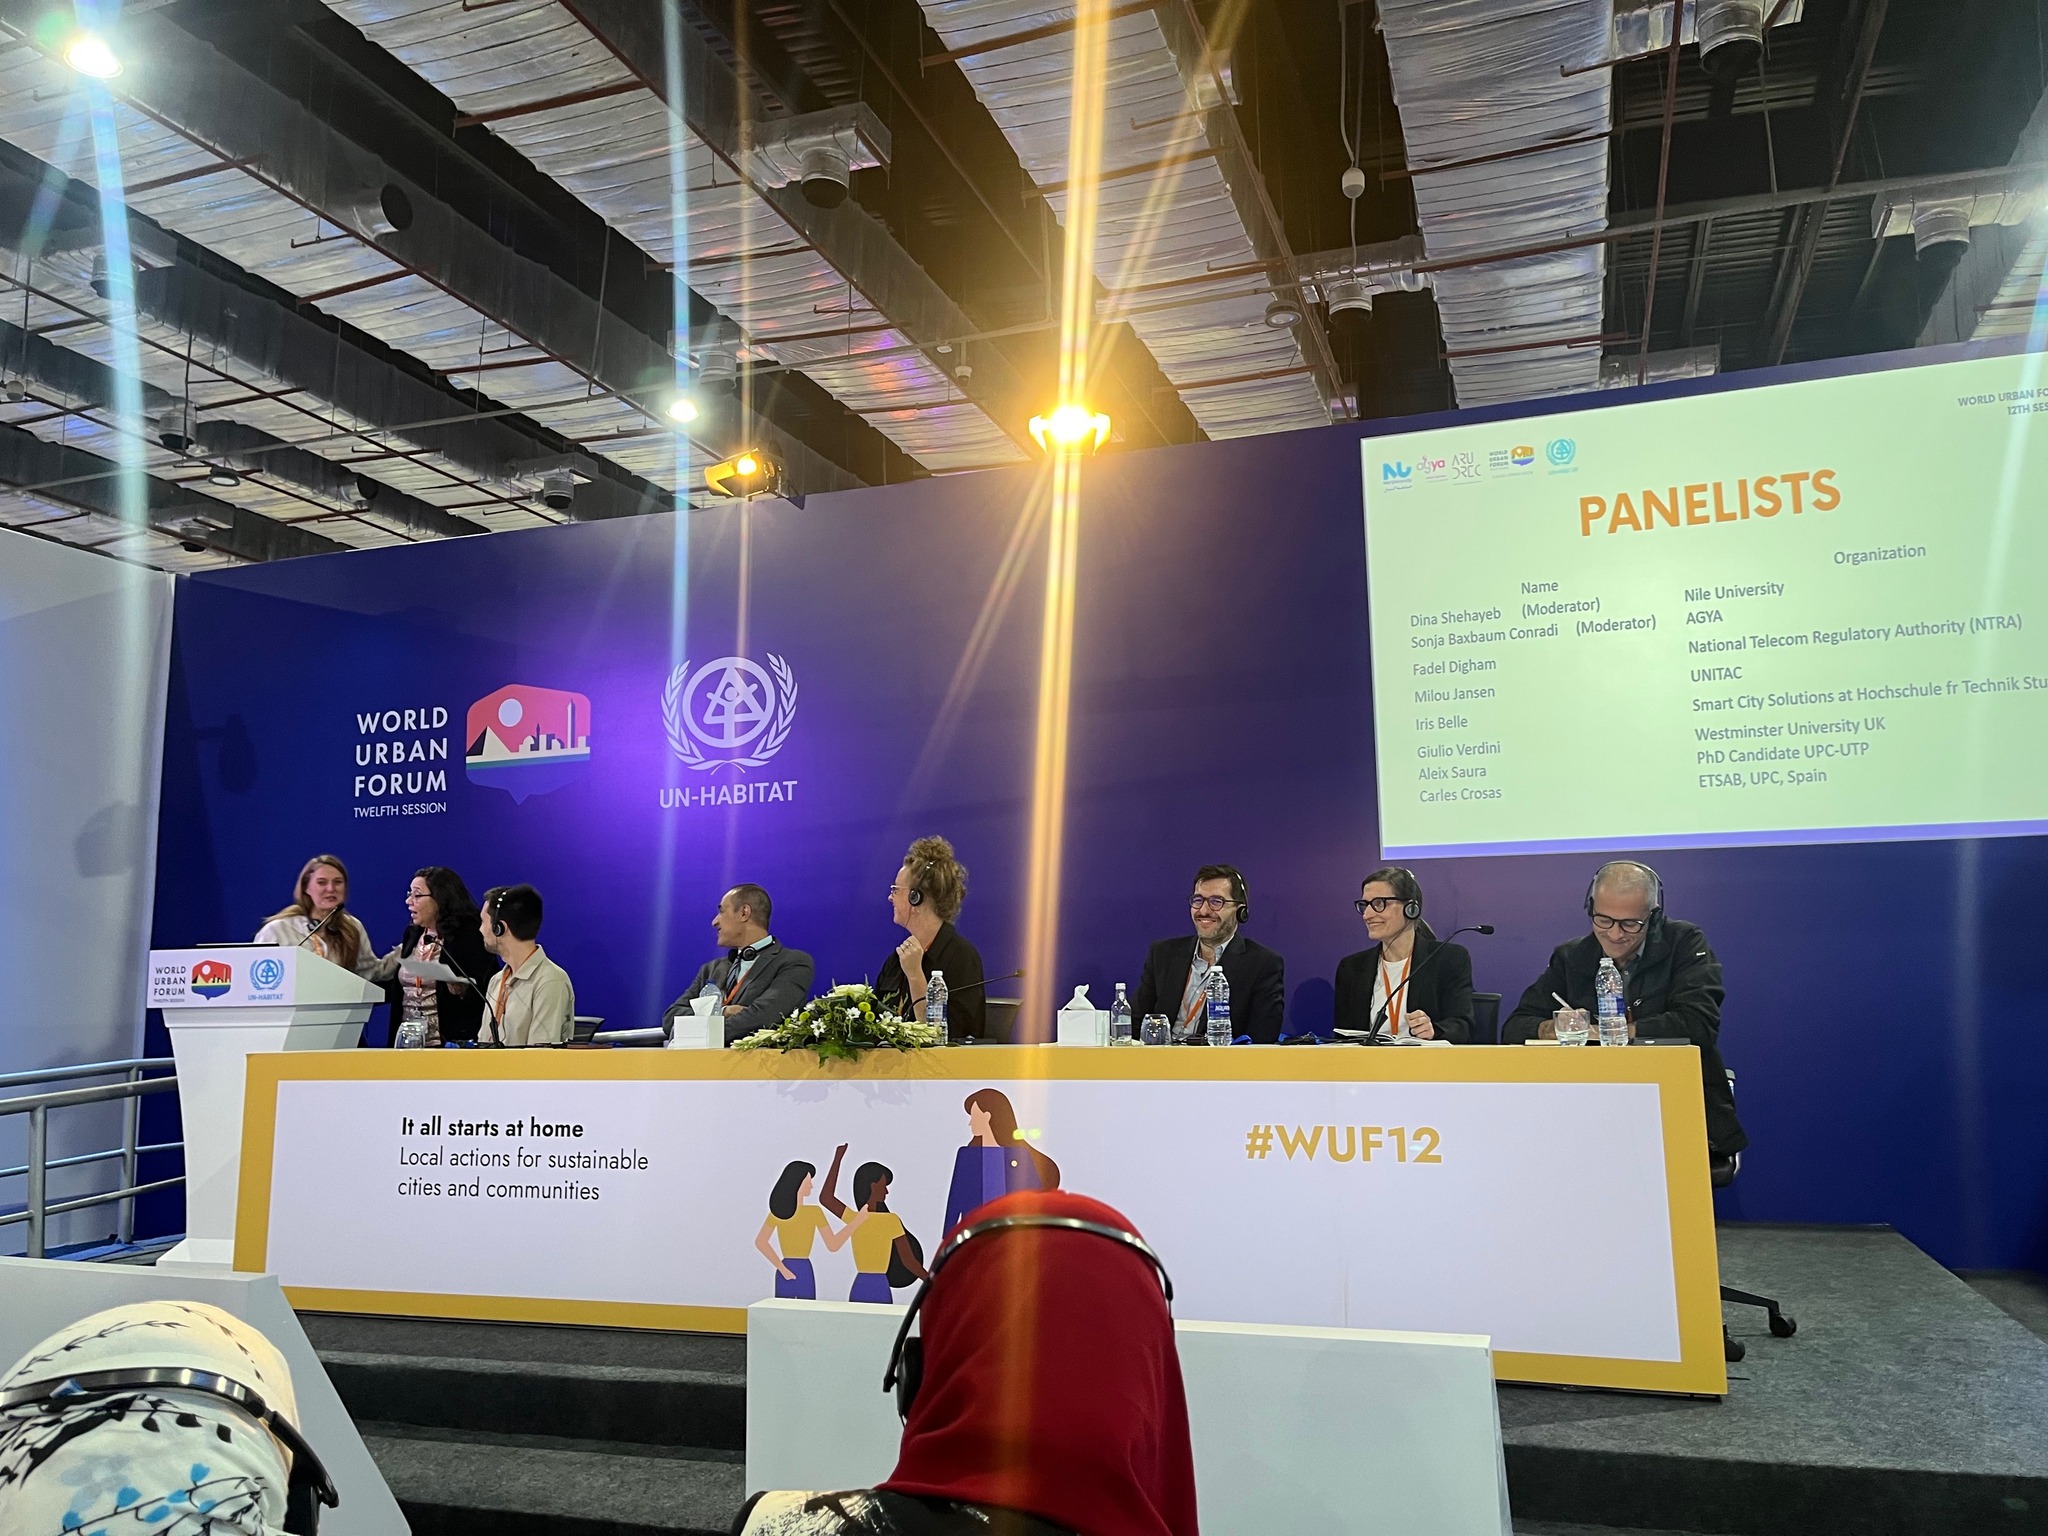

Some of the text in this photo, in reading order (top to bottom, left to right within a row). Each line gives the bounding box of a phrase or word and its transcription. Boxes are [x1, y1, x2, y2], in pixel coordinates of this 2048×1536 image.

[1957, 394, 1996, 406] WORLD
[1998, 390, 2034, 402] URBAN
[2007, 404, 2031, 416] 12TH
[1579, 469, 1842, 537] PANELISTS
[1833, 545, 1926, 566] Organization
[1521, 581, 1559, 594] Name
[1684, 582, 1785, 602] Nile University
[1410, 597, 1600, 627] Dina Shehayeb (Moderator)
[1685, 609, 1724, 625] AGYA
[1411, 614, 1657, 649] Sonja Baxbaum Conradi (Moderator)
[1688, 613, 2023, 654] National Telecom Regulatory Authority (NTRA)
[1413, 659, 1497, 676] Fadel Digham
[1690, 666, 1743, 683] UNITAC
[1414, 688, 1495, 703] Milou Jansen
[1692, 697, 1734, 712] Smart
[1737, 693, 1764, 710] City
[1768, 690, 1835, 707] Solutions
[1838, 689, 1853, 702] at
[1856, 682, 1943, 701] Hochschule
[1946, 680, 1958, 695] fr
[1961, 676, 2020, 694] Technik
[356, 706, 448, 735] WORLD
[1416, 715, 1468, 731] Iris Belle
[1695, 717, 1886, 742] Westminster University UK
[355, 738, 448, 766] URBAN
[1417, 741, 1501, 759] Giulio Verdini
[1697, 742, 1870, 764] PhD Candidate UPC-UTP
[354, 769, 447, 797] FORUM
[1418, 766, 1487, 780] Aleix Saura
[1699, 769, 1827, 789] ETSAB, UPC, Spain
[659, 780, 798, 808] UN-HABITAT
[1420, 788, 1502, 802] Carles Crosas
[354, 801, 447, 818] TWELFTH SESSION
[155, 966, 186, 975] WORLD
[154, 977, 186, 986] URBAN
[153, 988, 185, 996] FORUM
[402, 1115, 584, 1138] It all starts at home
[1244, 1124, 1443, 1165] #WUF12
[400, 1145, 649, 1170] Local actions for sustainable
[398, 1176, 600, 1200] cities and communities
